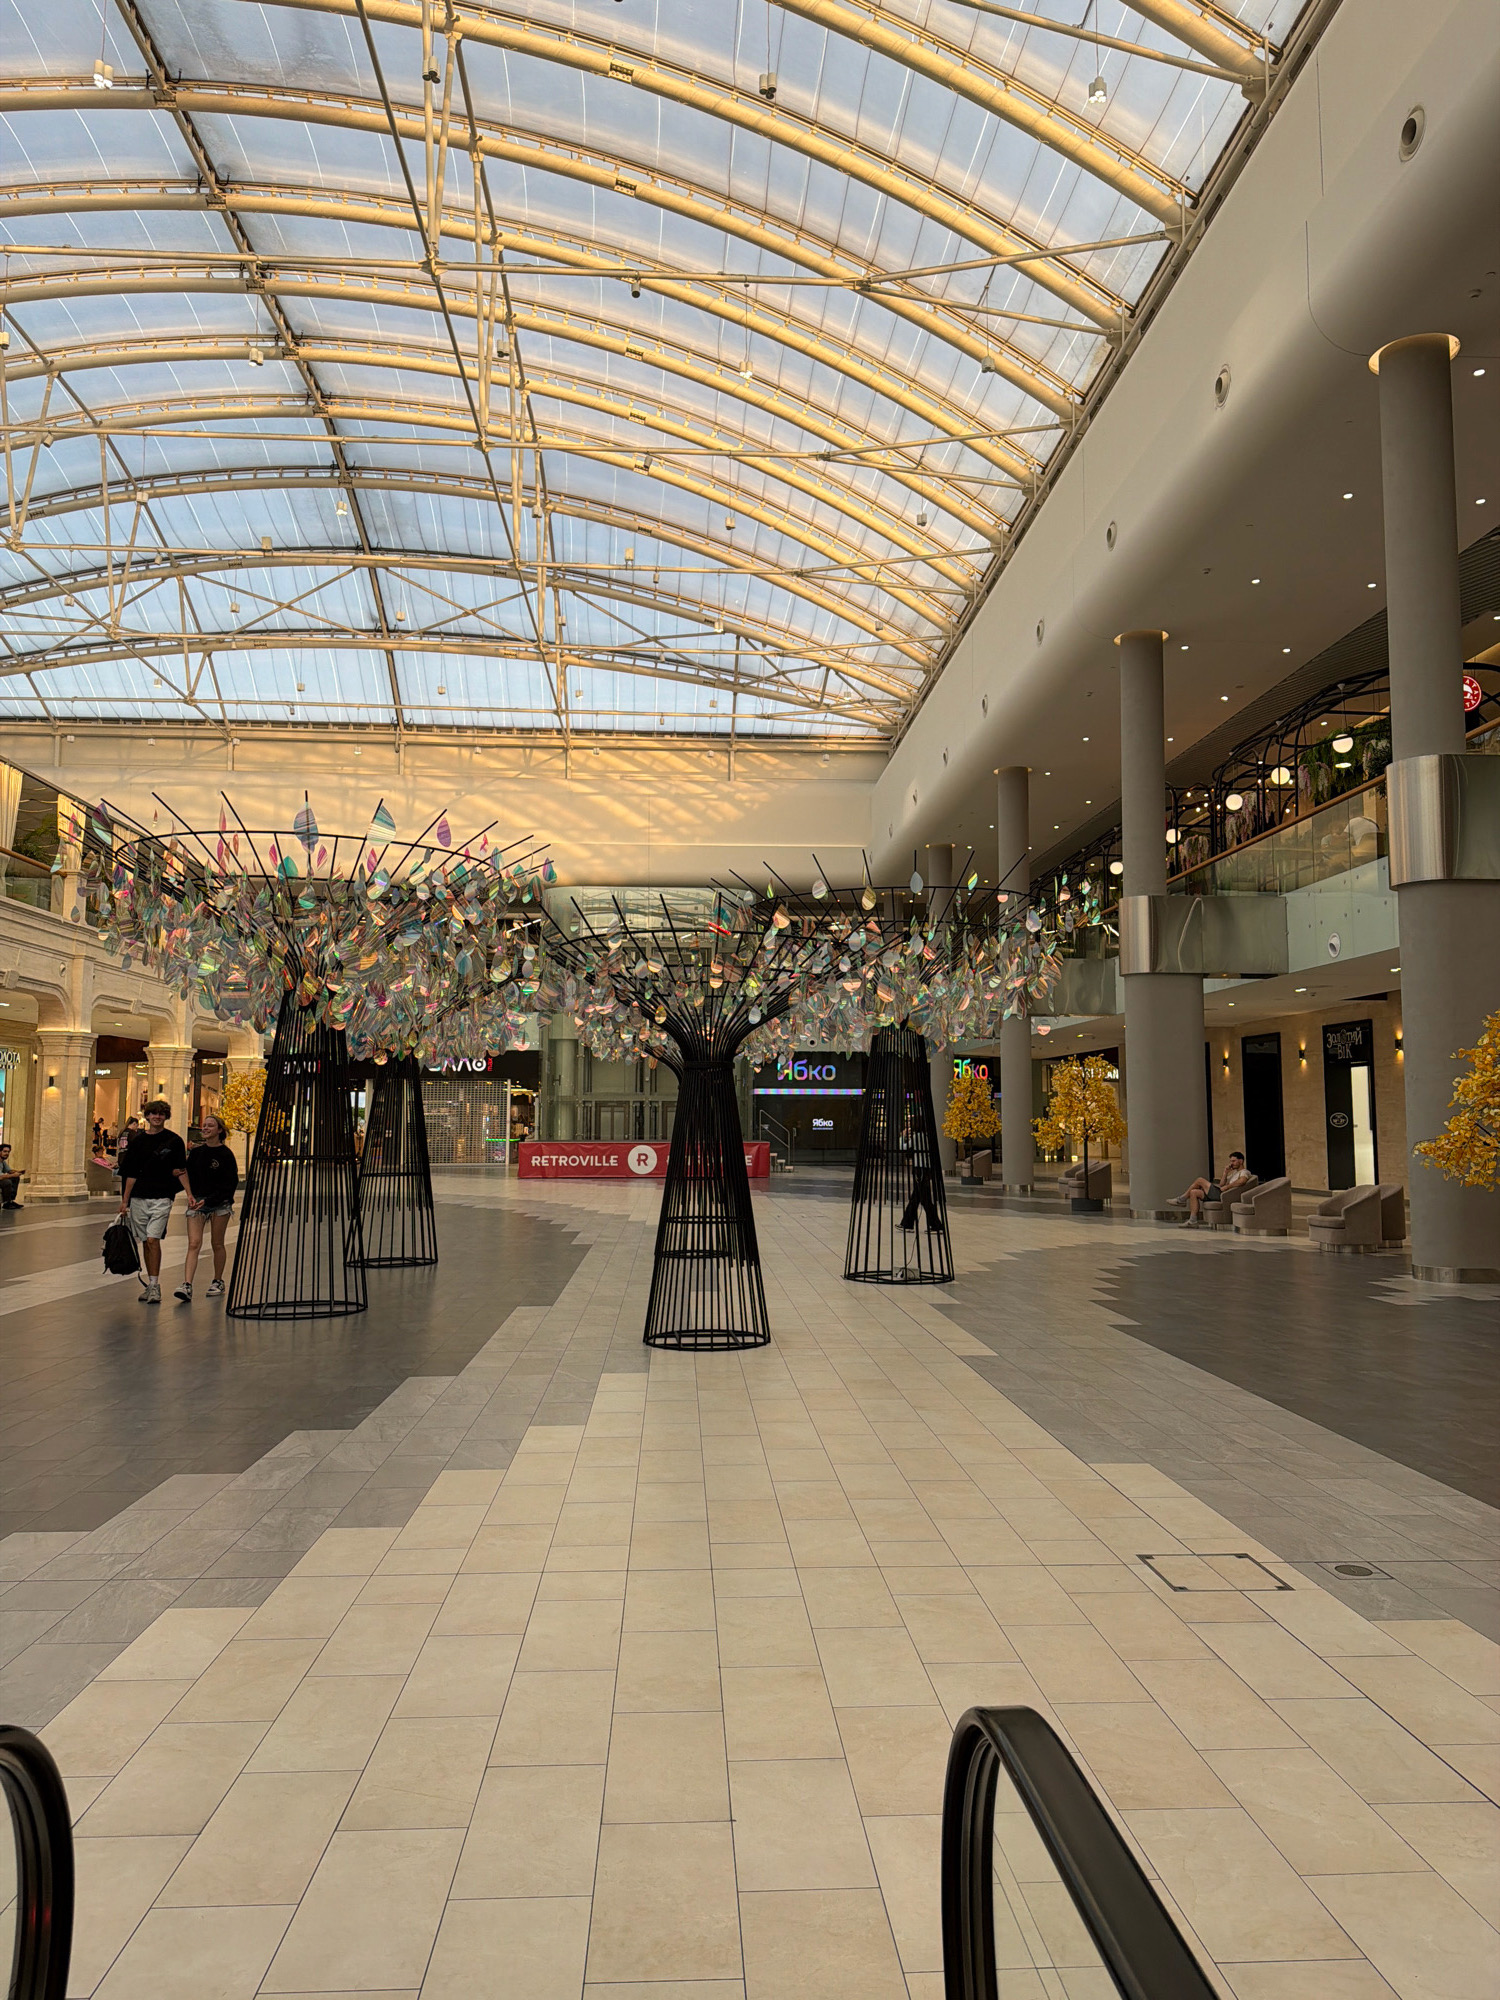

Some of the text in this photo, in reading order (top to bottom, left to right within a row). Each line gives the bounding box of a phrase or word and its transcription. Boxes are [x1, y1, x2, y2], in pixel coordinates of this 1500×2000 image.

[777, 1059, 837, 1081] Ябко
[953, 1058, 989, 1080] Ябко
[812, 1117, 834, 1127] Ябко
[530, 1152, 649, 1167] RETROVILLE R
